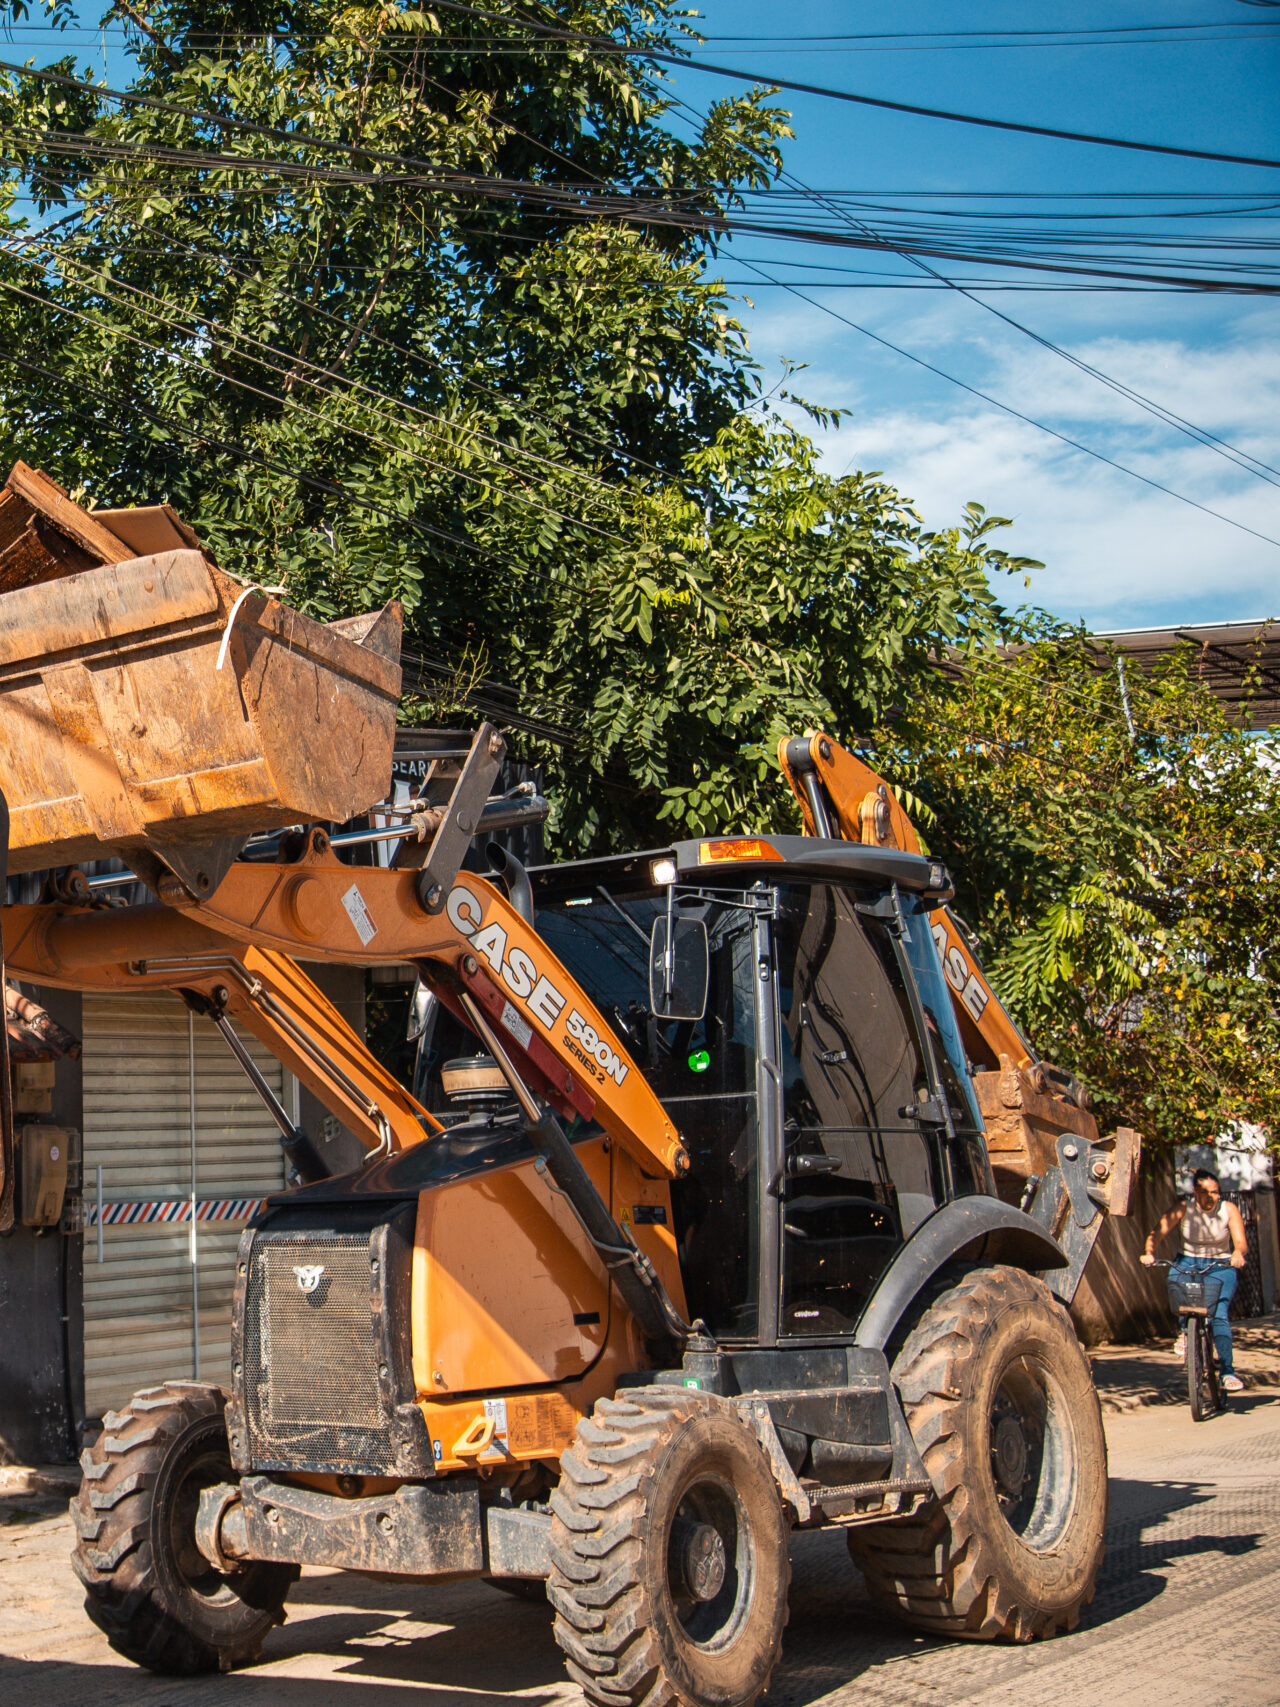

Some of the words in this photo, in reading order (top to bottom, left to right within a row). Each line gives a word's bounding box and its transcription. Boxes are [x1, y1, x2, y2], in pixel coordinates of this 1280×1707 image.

[446, 886, 567, 1031] CASE
[926, 911, 989, 1023] ASE
[562, 1035, 597, 1076] SERIES
[596, 1072, 606, 1085] 2
[566, 1008, 629, 1086] 580N
